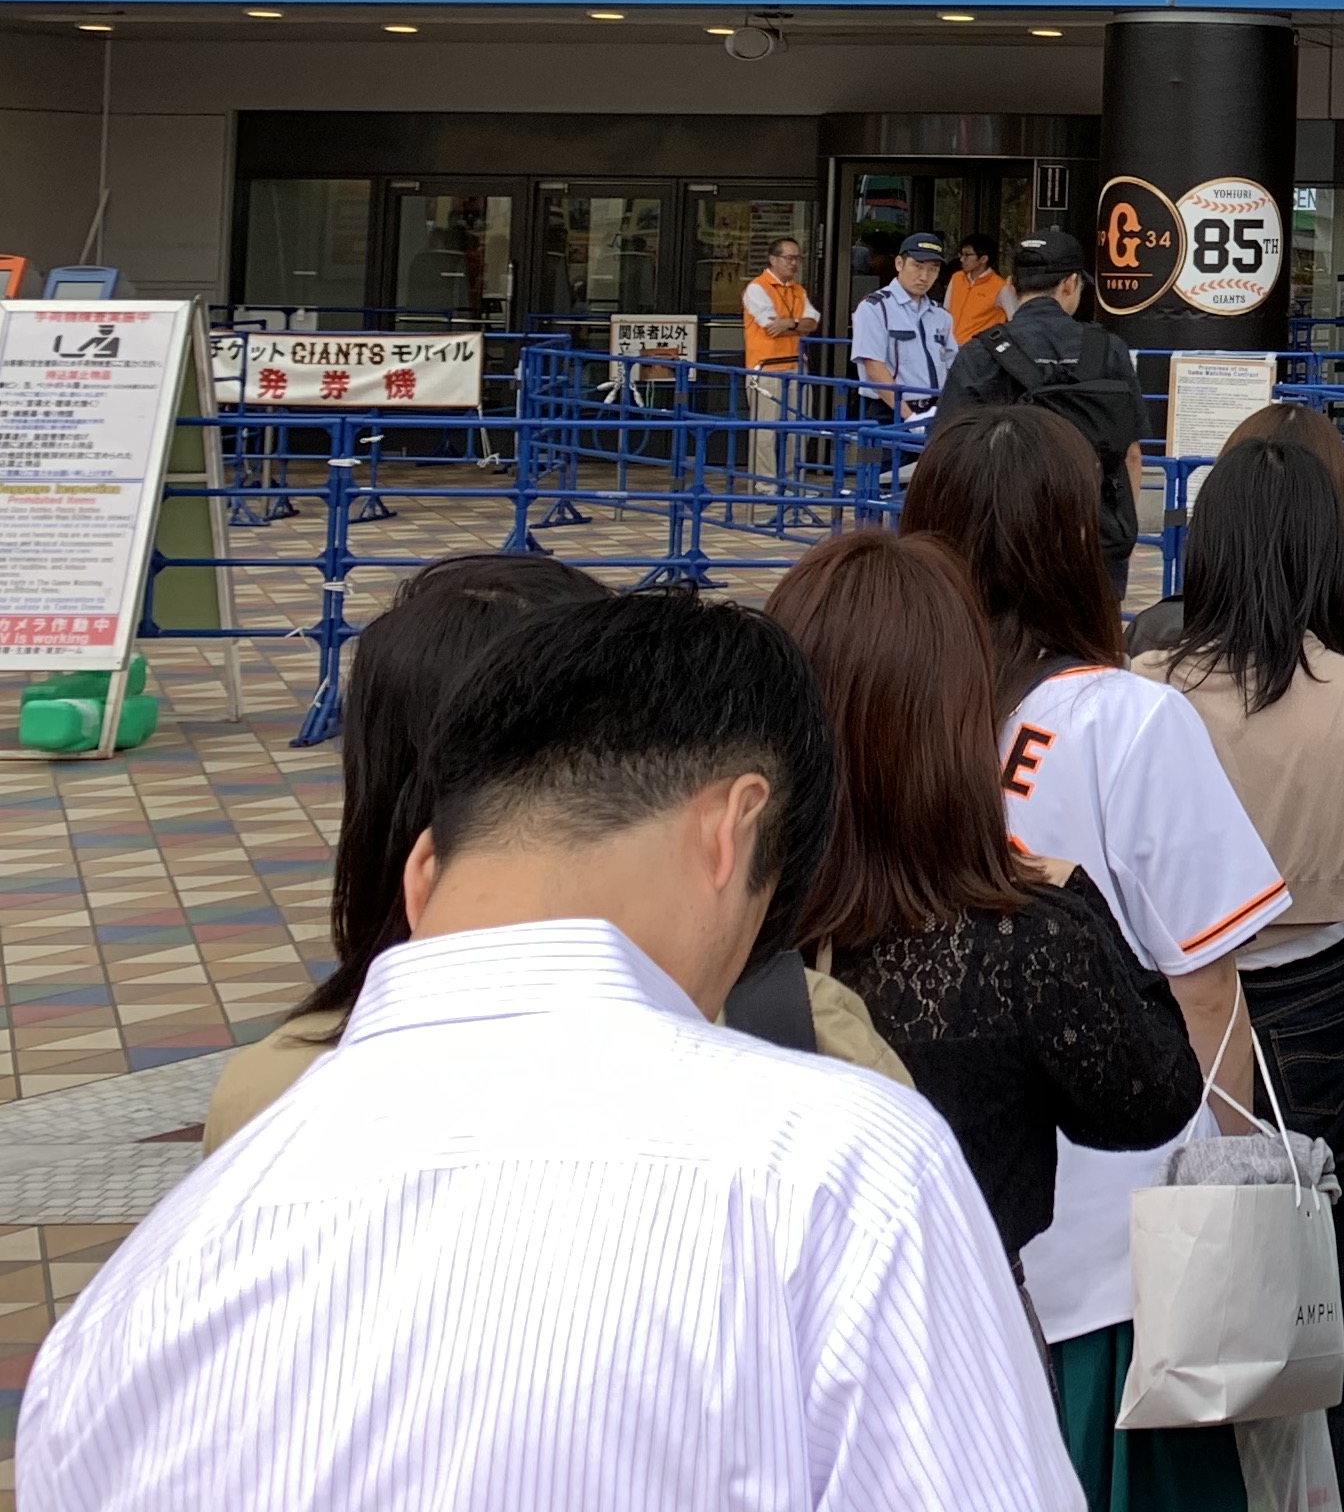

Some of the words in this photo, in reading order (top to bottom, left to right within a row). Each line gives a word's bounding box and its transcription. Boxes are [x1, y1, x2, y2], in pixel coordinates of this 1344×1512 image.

[1108, 202, 1142, 268] G
[1145, 230, 1172, 248] 34
[1107, 279, 1139, 290] TOKYO
[1213, 295, 1246, 304] GIANTS
[618, 325, 688, 340] 関係者以外
[291, 342, 386, 366] GIANTS
[391, 340, 474, 363] モバイル
[257, 368, 417, 400] 発券機
[33, 633, 90, 646] working
[1001, 721, 1057, 801] E
[1295, 1301, 1338, 1326] AMPHI
